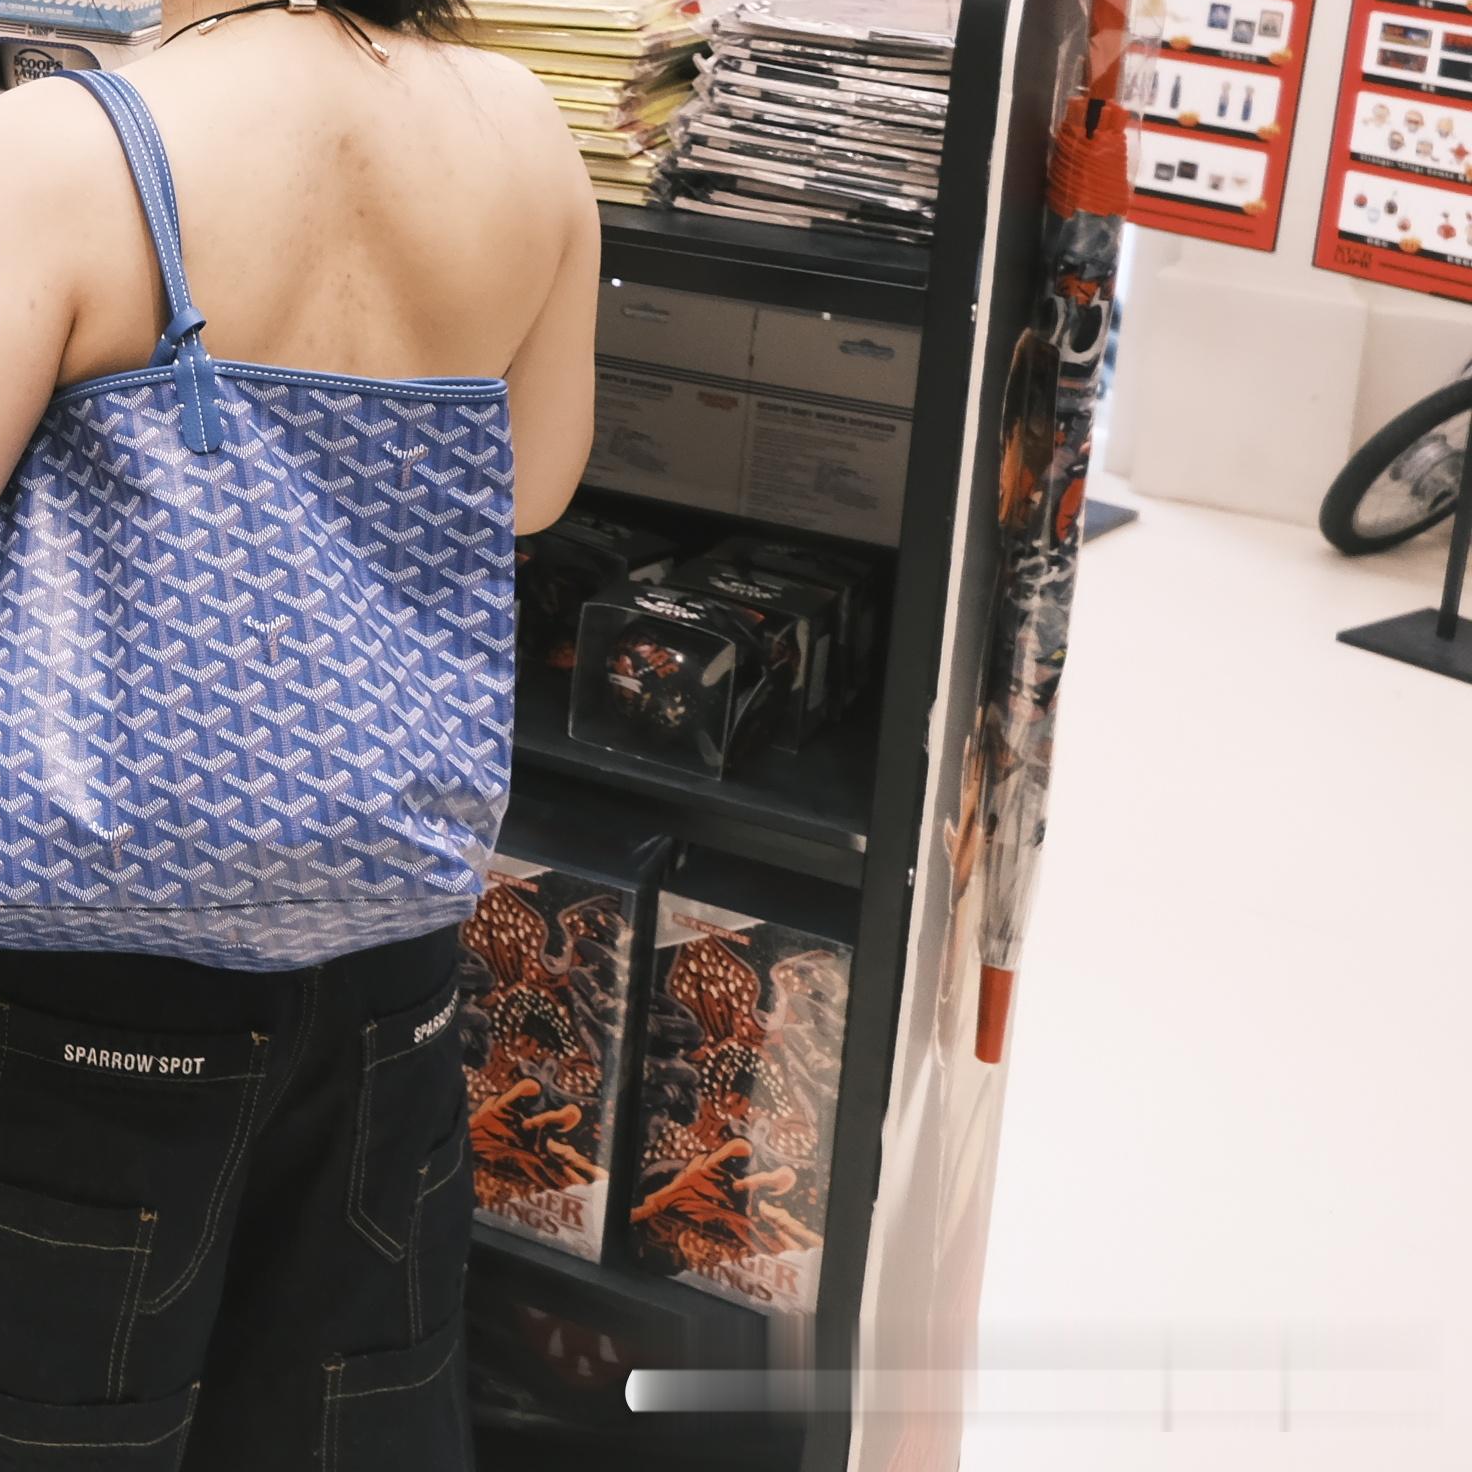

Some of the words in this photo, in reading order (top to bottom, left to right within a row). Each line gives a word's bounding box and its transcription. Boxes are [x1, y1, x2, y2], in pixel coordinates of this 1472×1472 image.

[14, 55, 64, 72] SCOOPS
[64, 1044, 153, 1073] SPARROW
[158, 1056, 205, 1075] SPOT
